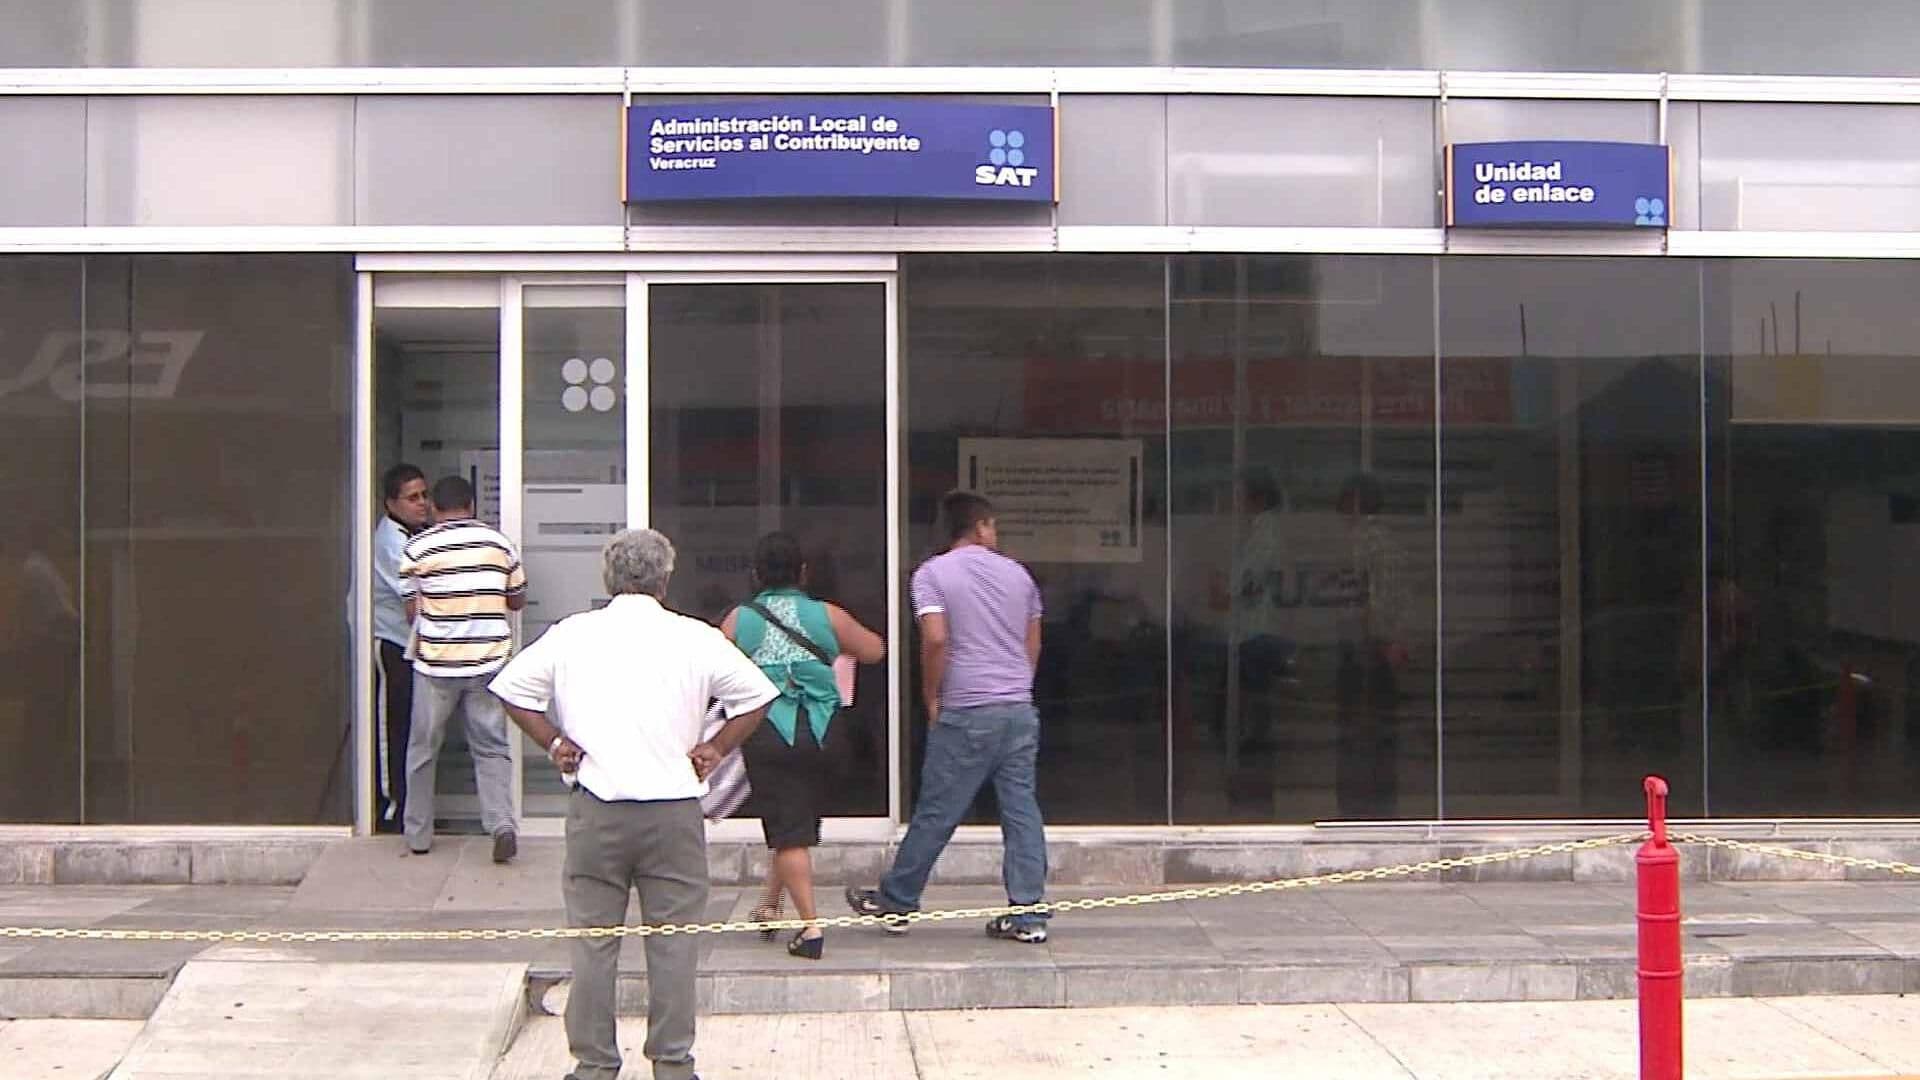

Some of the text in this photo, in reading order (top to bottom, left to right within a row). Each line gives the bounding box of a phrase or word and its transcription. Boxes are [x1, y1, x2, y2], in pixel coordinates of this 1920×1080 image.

[650, 114, 899, 136] Administración Local de
[650, 133, 921, 154] Servicios al Contribuyente
[649, 157, 716, 170] Veracruz
[1475, 161, 1562, 183] Unidad
[976, 165, 1038, 187] SAT
[1474, 183, 1595, 204] de enlace
